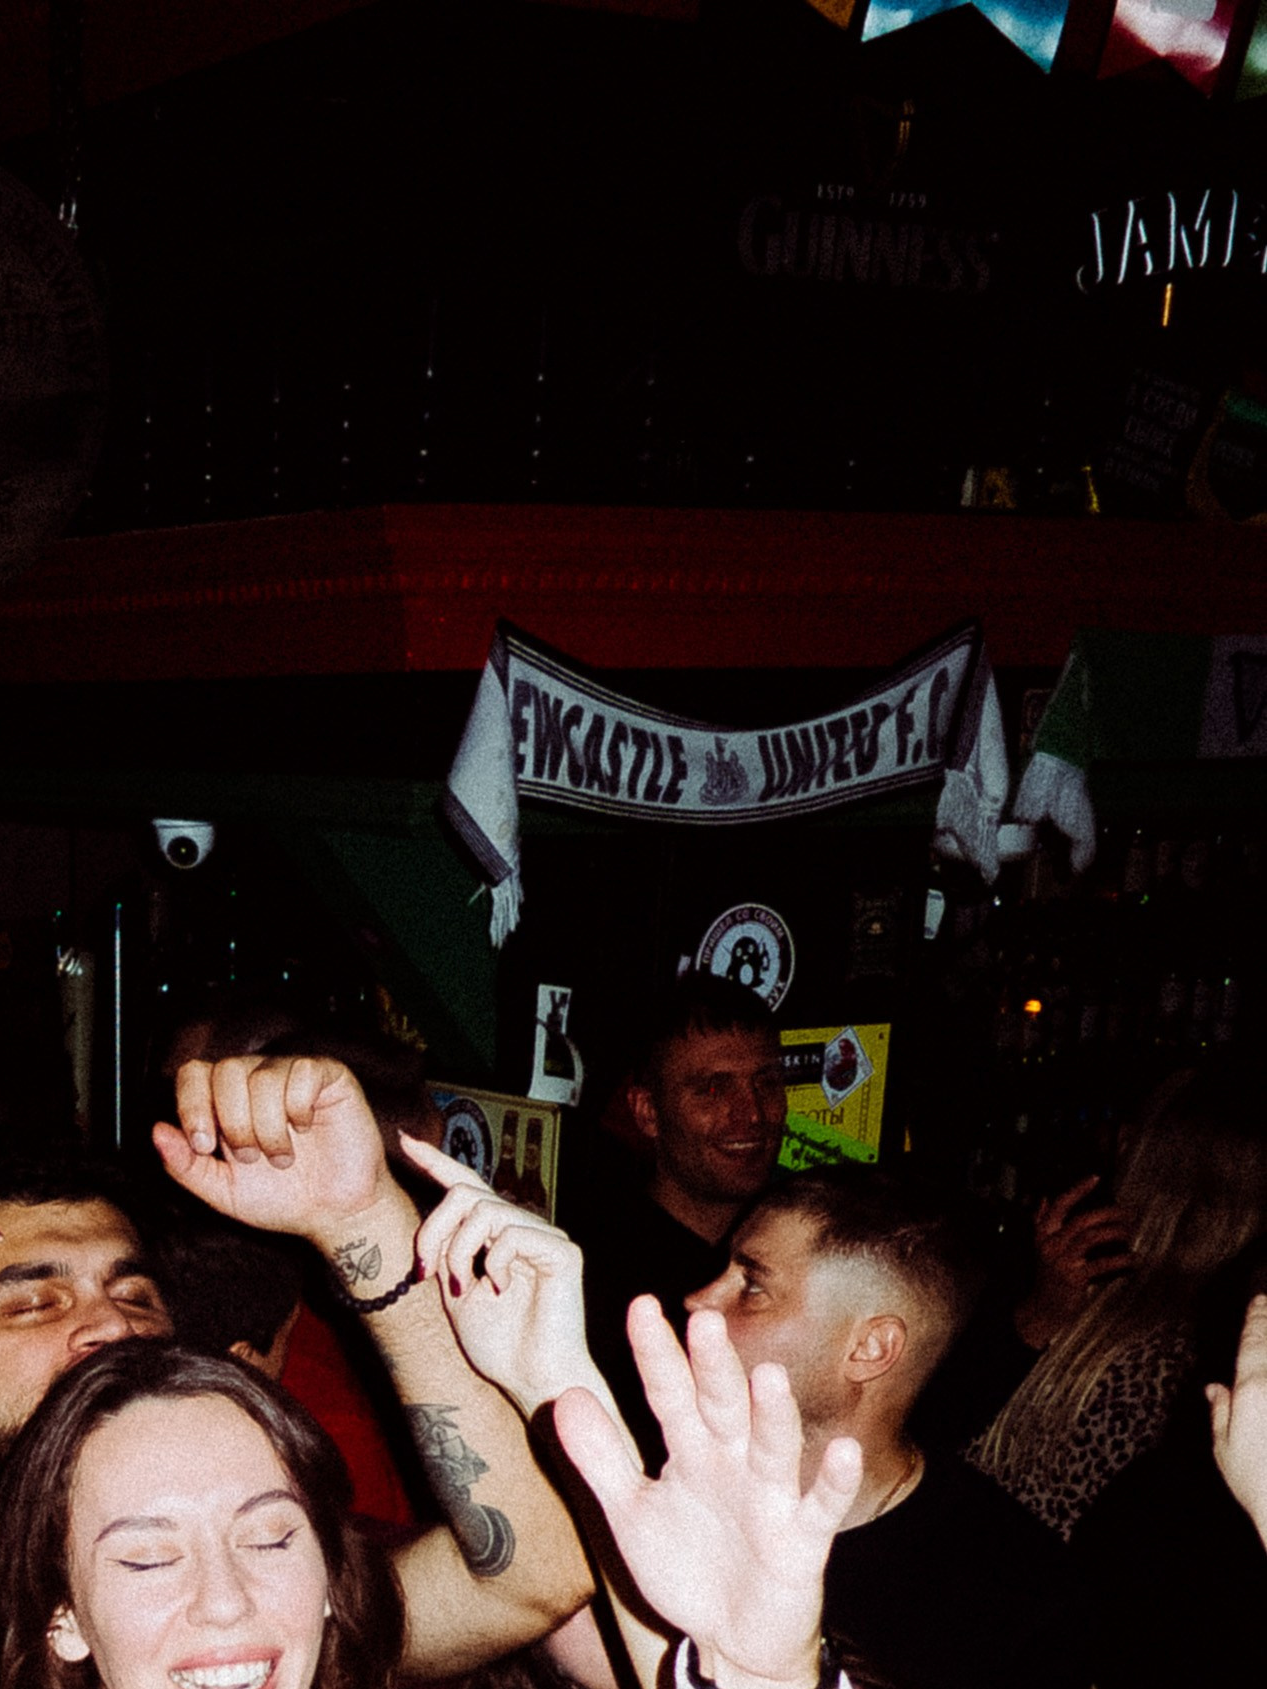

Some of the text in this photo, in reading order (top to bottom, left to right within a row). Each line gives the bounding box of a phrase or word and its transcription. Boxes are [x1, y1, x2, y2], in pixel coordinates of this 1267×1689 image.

[736, 193, 991, 295] GUINNESS
[509, 678, 688, 804] EWCASTLE
[756, 702, 891, 803] UNITED
